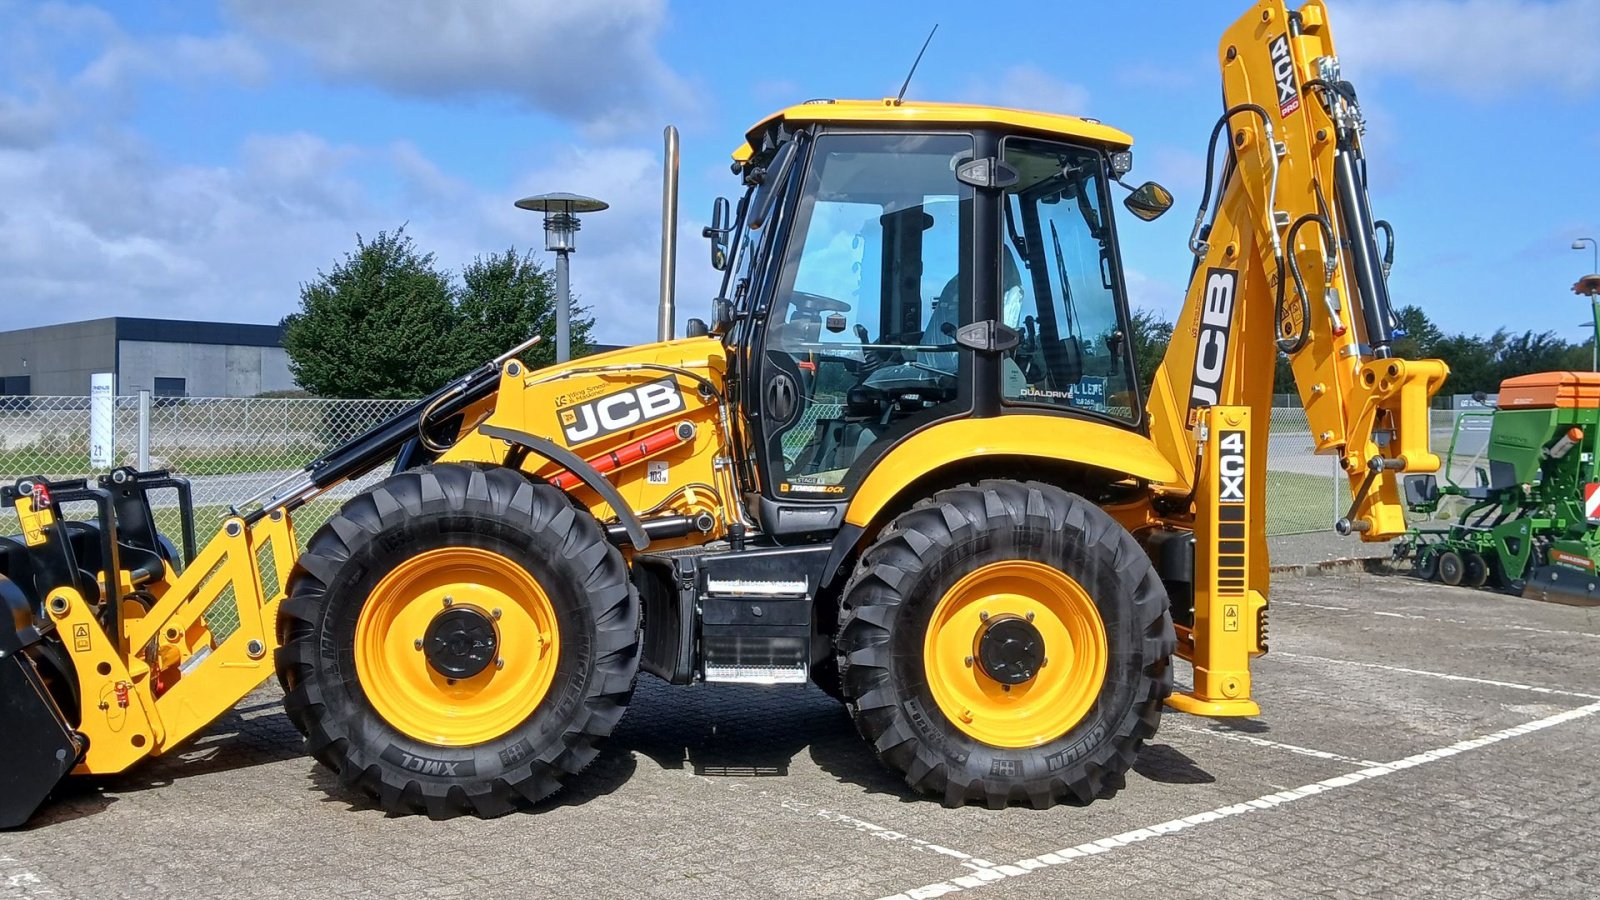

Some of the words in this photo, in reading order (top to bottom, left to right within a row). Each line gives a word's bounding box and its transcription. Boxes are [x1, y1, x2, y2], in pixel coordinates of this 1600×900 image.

[1272, 36, 1296, 102] 4CX
[1281, 100, 1299, 116] PRO
[1020, 388, 1073, 399] DUALDRIVE
[566, 380, 681, 441] JCB
[649, 470, 662, 482] 103
[1220, 433, 1245, 498] 4CX
[401, 753, 459, 776] XMCL
